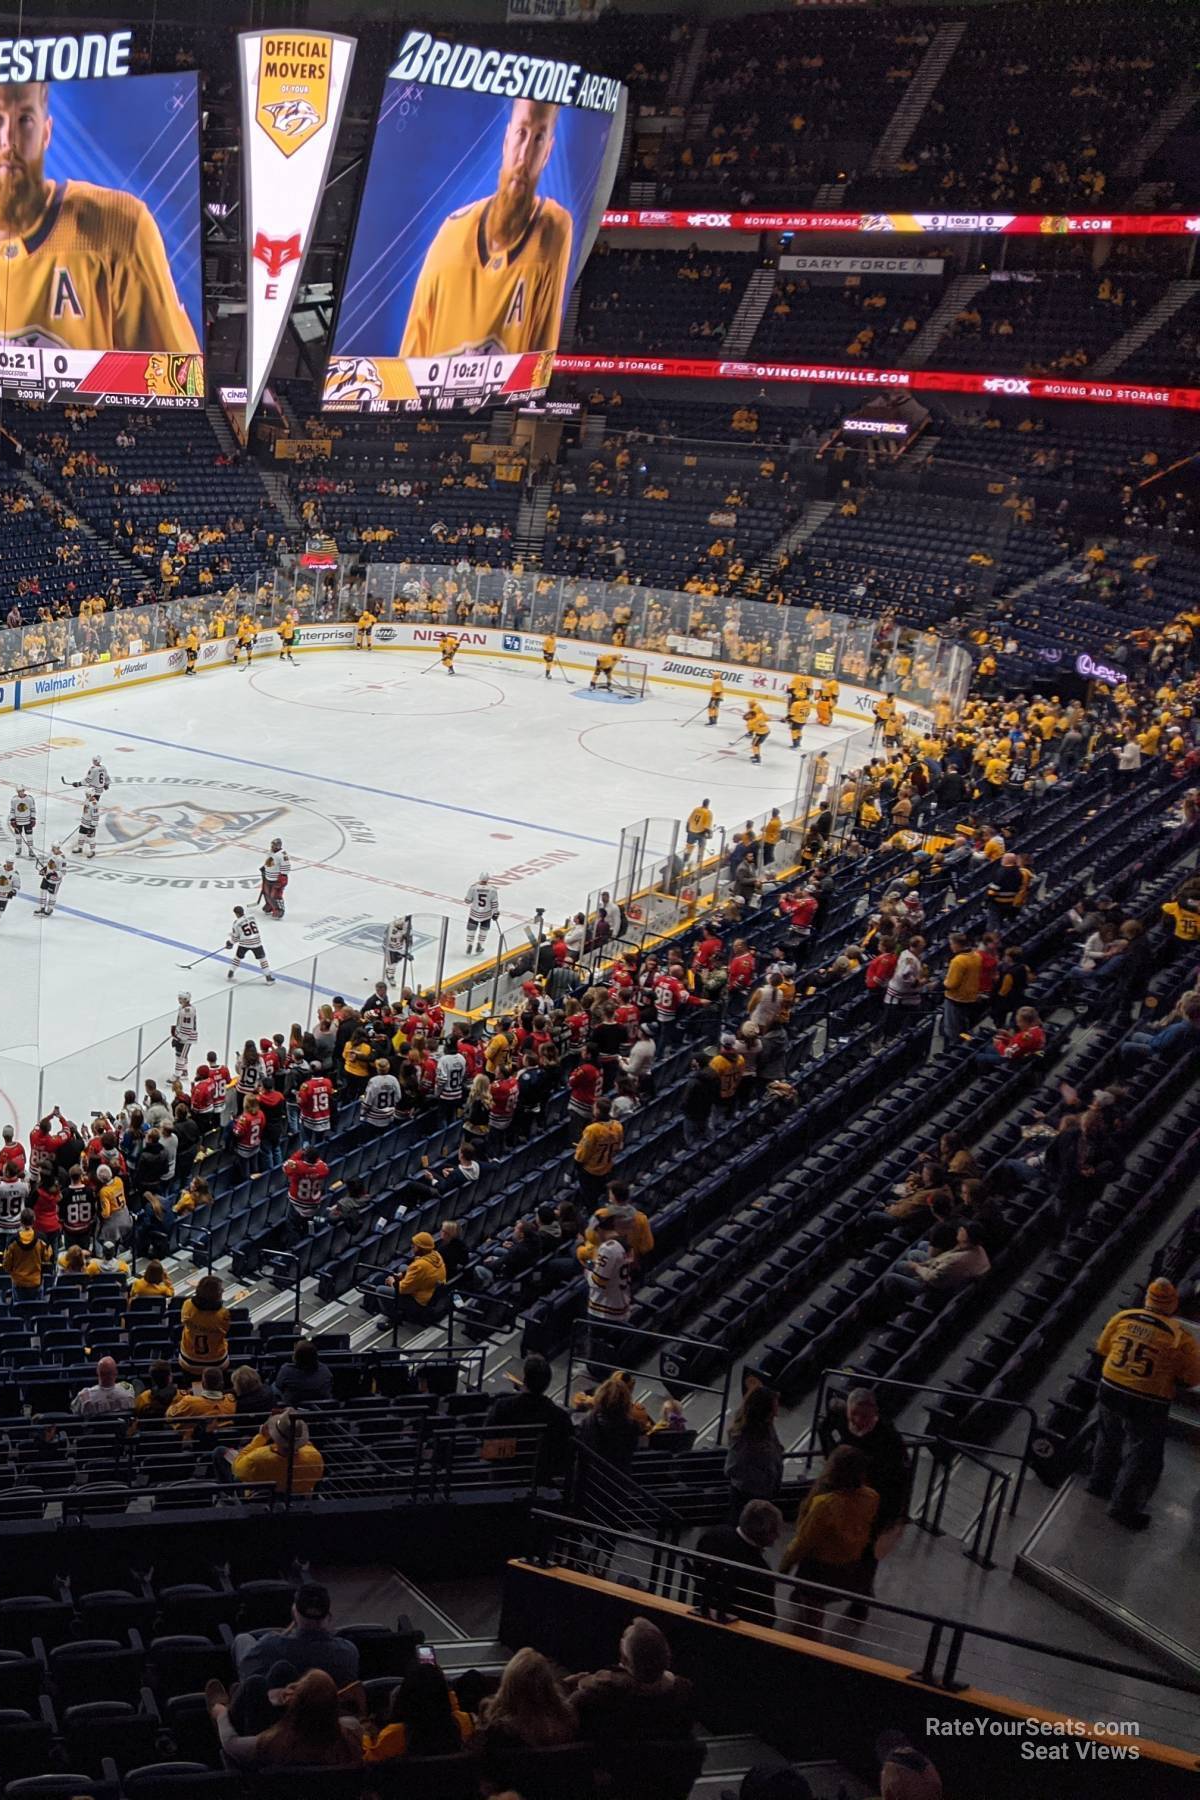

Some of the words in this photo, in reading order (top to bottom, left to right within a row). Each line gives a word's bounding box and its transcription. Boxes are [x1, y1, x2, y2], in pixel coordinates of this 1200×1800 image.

[265, 40, 328, 58] OFFICIAL
[264, 62, 326, 79] MOVERS
[388, 31, 581, 105] BRIDGESTONE
[575, 72, 622, 113] ARENA
[601, 214, 629, 223] 408
[697, 213, 732, 228] FOX
[744, 217, 784, 226] MOVING
[786, 217, 808, 226] AND
[810, 217, 858, 227] STORAGE
[931, 217, 939, 226] 0
[950, 217, 976, 226] 10:21
[985, 217, 994, 226] 0
[795, 259, 844, 270] GARY
[857, 259, 908, 272] FORCE
[264, 284, 279, 300] E
[53, 355, 68, 374] 0
[428, 362, 440, 382] 0
[452, 362, 484, 379] 10:21
[493, 360, 503, 378] 0
[554, 359, 592, 369] MOVING
[594, 360, 615, 370] AND
[617, 361, 665, 371] STORAGE
[48, 379, 56, 389] 0
[756, 366, 910, 384] OVINGNASHVILLE.COM
[17, 389, 34, 400] 9:00
[34, 391, 45, 400] PM
[992, 379, 1031, 395] FOX
[1044, 384, 1087, 396] MOVING
[1090, 386, 1113, 398] AND
[1116, 388, 1170, 401] STORAGE
[105, 395, 123, 405] COL:
[123, 396, 146, 406] 11-6-2
[156, 397, 175, 407] VAN:
[175, 398, 199, 408] 10-7-3
[369, 400, 391, 412] NHL
[404, 399, 423, 411] COL
[435, 396, 455, 409] VAN
[546, 402, 580, 410] NASHVILLE
[551, 408, 574, 416] HOTEL
[413, 629, 488, 645] NISSAN
[661, 660, 745, 684] BRIDGESTONE
[34, 675, 76, 694] Walmart
[109, 776, 319, 804] BRIDGESTONE
[327, 814, 377, 845] ARENA
[65, 863, 263, 890] BRIDGESTO
[487, 849, 580, 886] NISSAN
[476, 893, 488, 908] 5
[240, 1064, 258, 1083] 19
[312, 1093, 330, 1113] 19
[377, 1091, 396, 1109] 81
[250, 1124, 261, 1145] 2
[0, 1195, 23, 1218] 19
[66, 1202, 92, 1224] 88
[1110, 1335, 1161, 1378] 35
